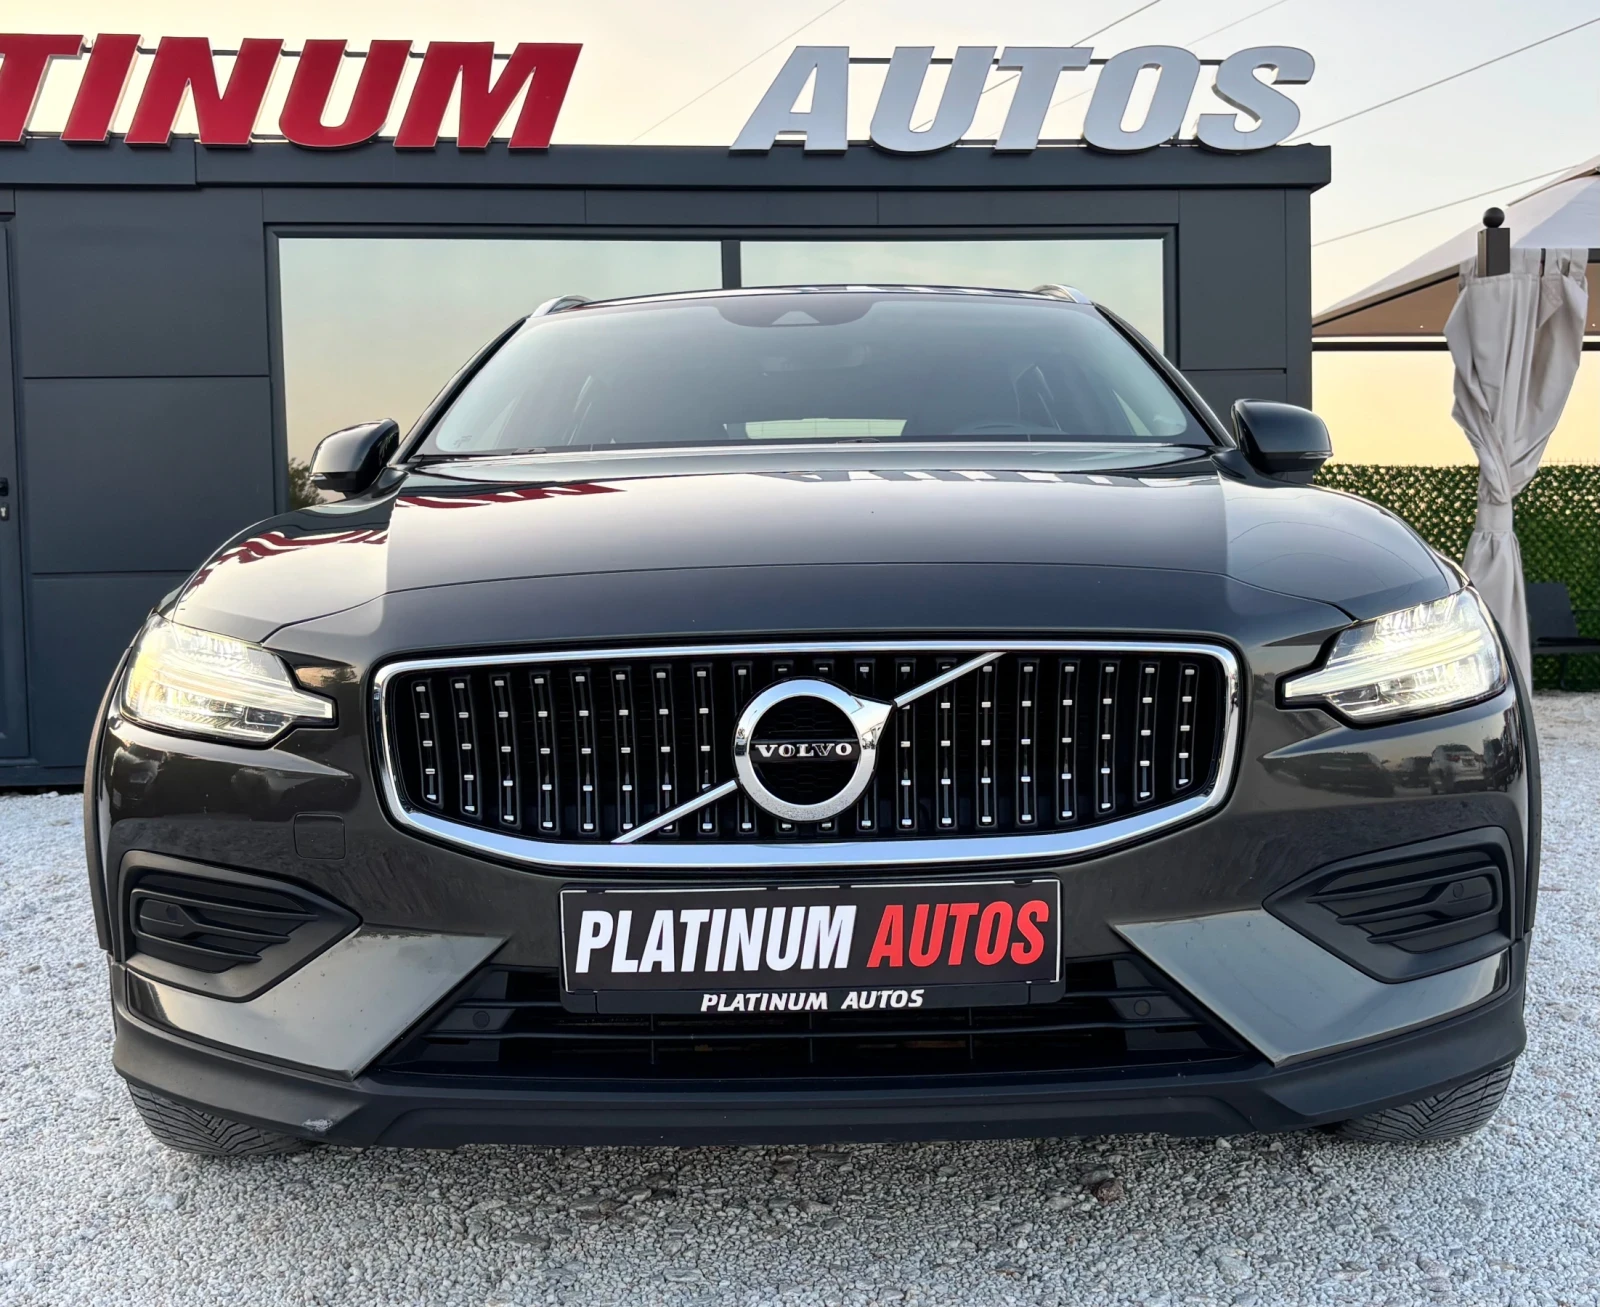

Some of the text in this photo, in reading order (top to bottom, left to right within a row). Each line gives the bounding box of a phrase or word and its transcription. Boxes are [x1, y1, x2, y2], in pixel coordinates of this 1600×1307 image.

[729, 45, 1315, 153] AUTOS
[755, 742, 853, 757] VOLVO
[575, 899, 1050, 974] PLATINUM AUTOS
[700, 989, 925, 1012] PLATINUM AUTOS
